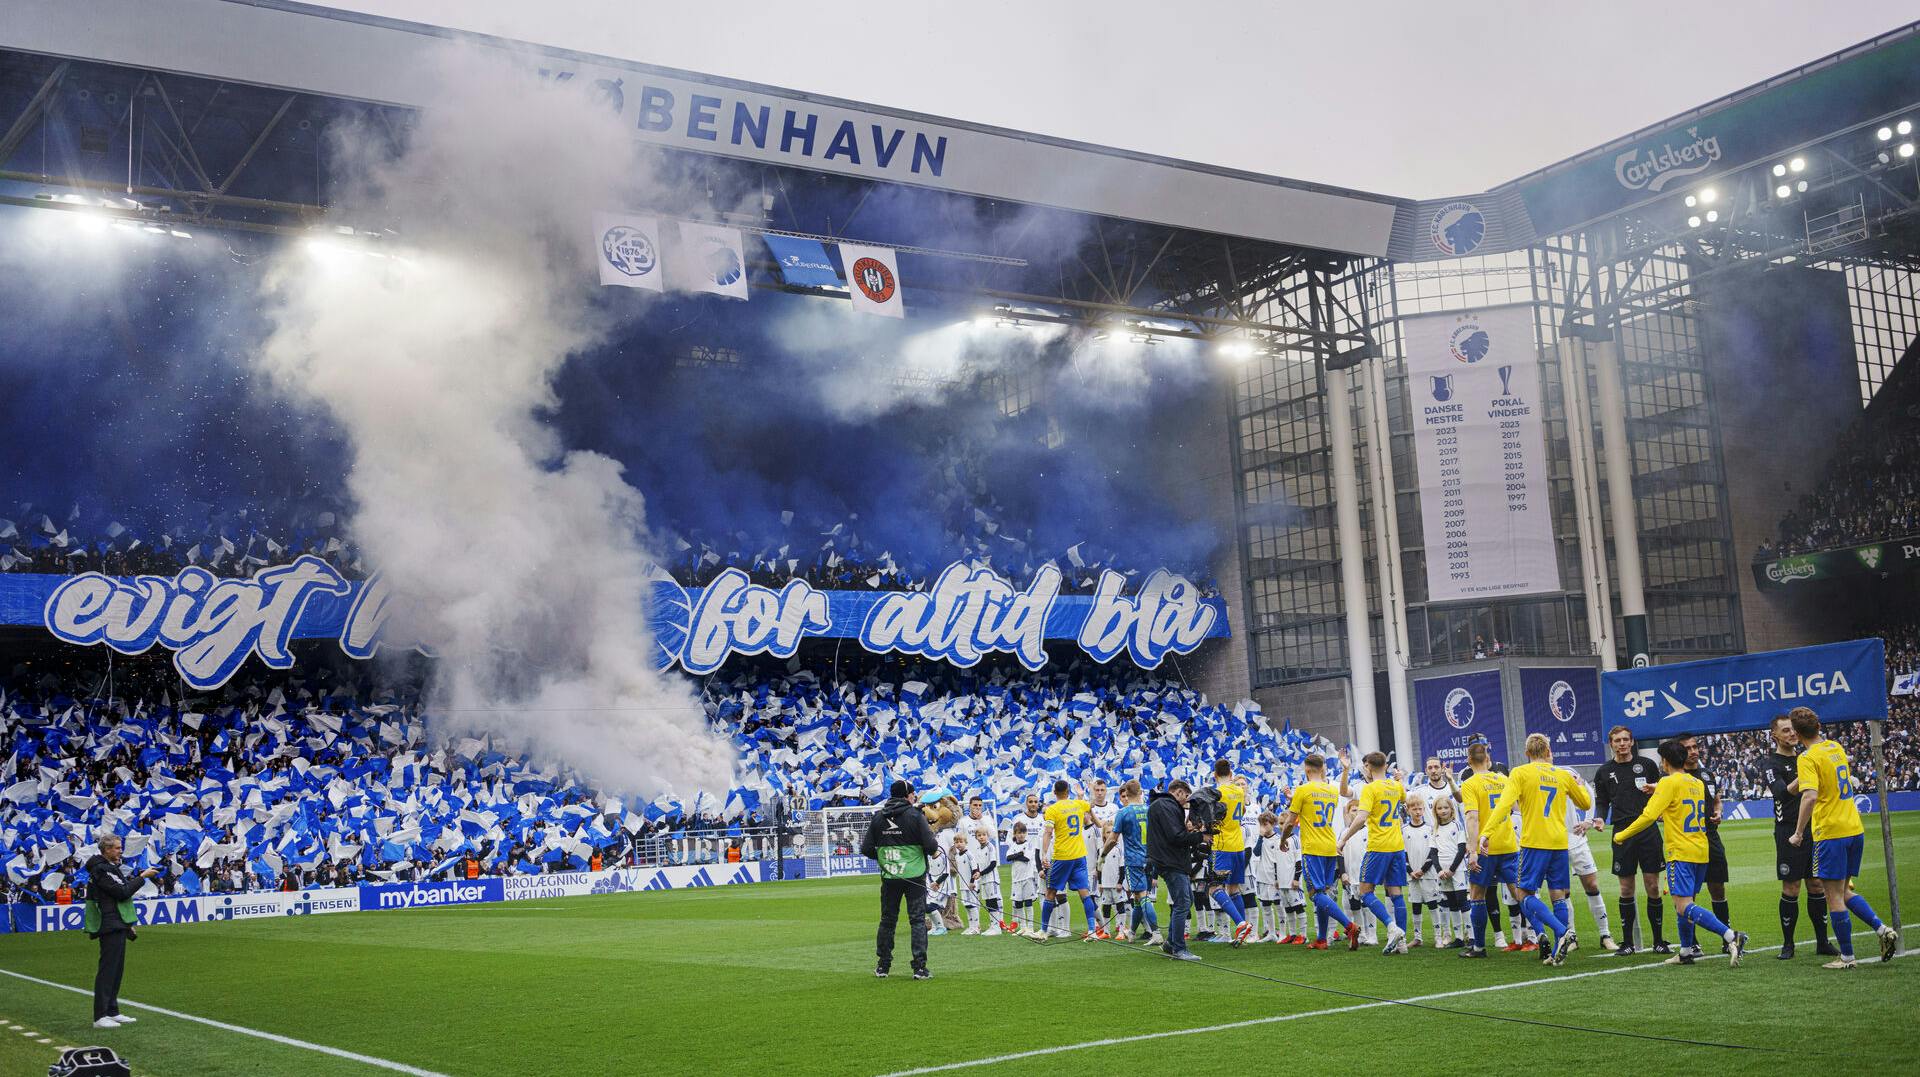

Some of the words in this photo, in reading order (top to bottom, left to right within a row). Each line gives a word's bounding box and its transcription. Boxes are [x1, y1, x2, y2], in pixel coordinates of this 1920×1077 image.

[1615, 136, 1721, 190] Carlsberg
[1491, 398, 1524, 407] POKAL
[1424, 404, 1463, 415] DANSKE
[1488, 407, 1530, 418] VINDERE
[1426, 414, 1464, 425] MESTRE
[1500, 421, 1520, 429] 2023
[1436, 427, 1457, 436] 2023
[1502, 431, 1520, 439] 2017
[1436, 437, 1457, 446] 2022
[1439, 447, 1458, 456] 2019
[1504, 452, 1522, 460] 2015
[1440, 457, 1458, 466] 2017
[1505, 462, 1523, 470] 2012
[1441, 468, 1460, 477] 2016
[1505, 473, 1525, 481] 2009
[1442, 479, 1461, 487] 2013
[1506, 483, 1526, 491] 2004
[1444, 489, 1461, 497] 2011
[1507, 493, 1526, 501] 1997
[1444, 499, 1463, 508] 2010
[1508, 504, 1528, 512] 1995
[1444, 509, 1465, 518] 2009
[1445, 519, 1466, 528] 2007
[1446, 530, 1467, 539] 2006
[1447, 540, 1468, 549] 2004
[1448, 551, 1469, 559] 2003
[1450, 562, 1469, 570] 2001
[1451, 572, 1470, 580] 1993
[1766, 561, 1815, 583] Carlsberg
[46, 556, 351, 690] evigt
[681, 568, 831, 674] for
[858, 560, 1062, 671] altid
[1078, 567, 1217, 670] blå
[1624, 689, 1654, 718] 3F
[1695, 671, 1851, 708] SUPERLIGA
[1451, 737, 1460, 746] VI
[1836, 765, 1853, 800] 8
[792, 798, 805, 809] 12
[1540, 785, 1557, 817] 7
[1232, 802, 1243, 821] 4
[1313, 800, 1336, 828] 30
[1380, 799, 1401, 827] 24
[1067, 815, 1080, 836] 9
[505, 873, 588, 889] BROLÆGNING
[380, 882, 486, 908] mybanker
